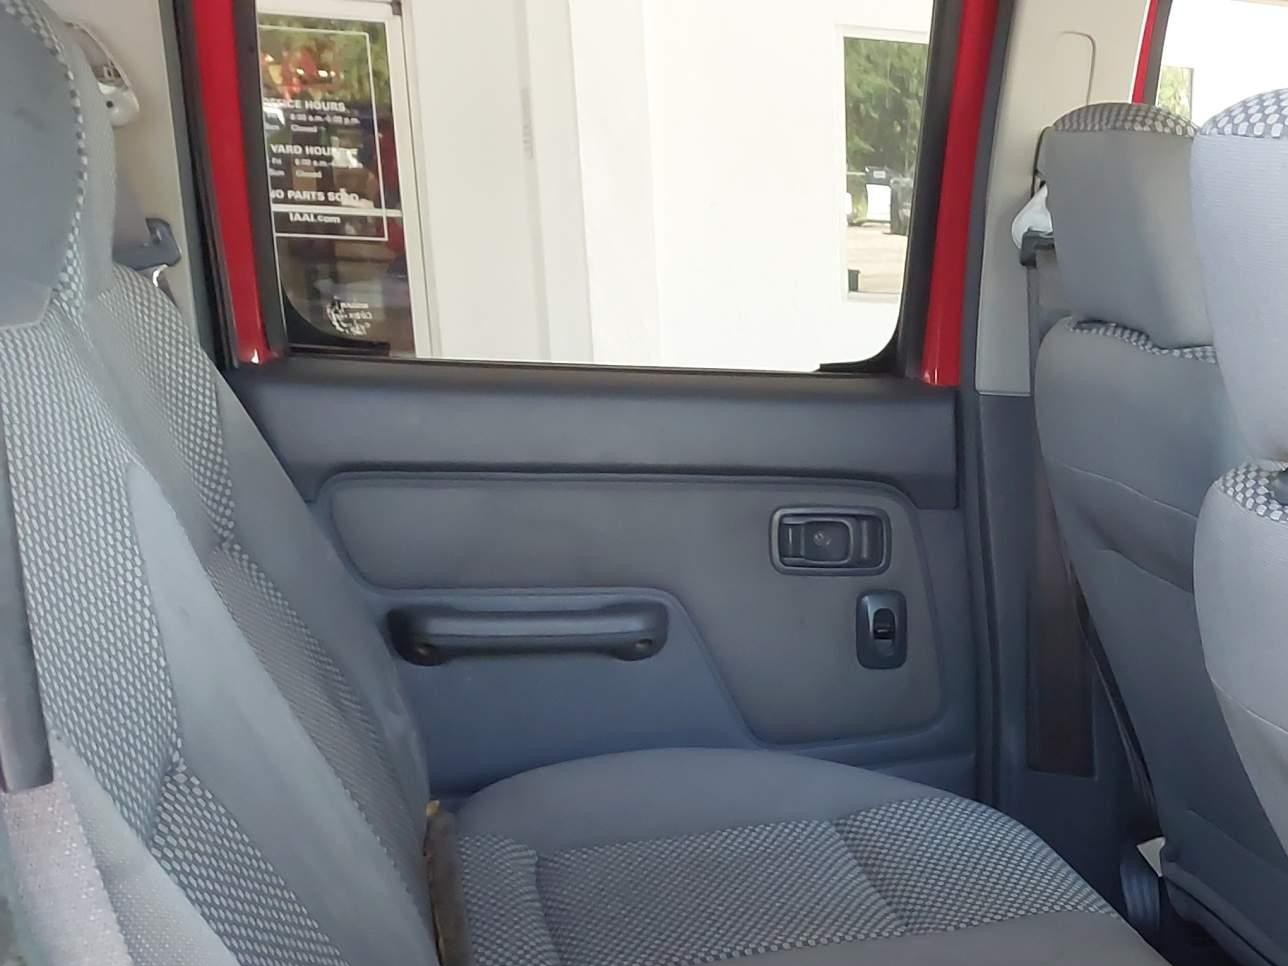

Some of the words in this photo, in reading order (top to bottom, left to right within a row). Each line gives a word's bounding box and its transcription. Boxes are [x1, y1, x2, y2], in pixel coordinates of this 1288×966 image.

[304, 99, 347, 112] HOURS
[270, 143, 303, 154] YARD
[305, 145, 348, 157] HOU
[287, 190, 325, 202] PARTS
[289, 212, 341, 224] IAAI.com
